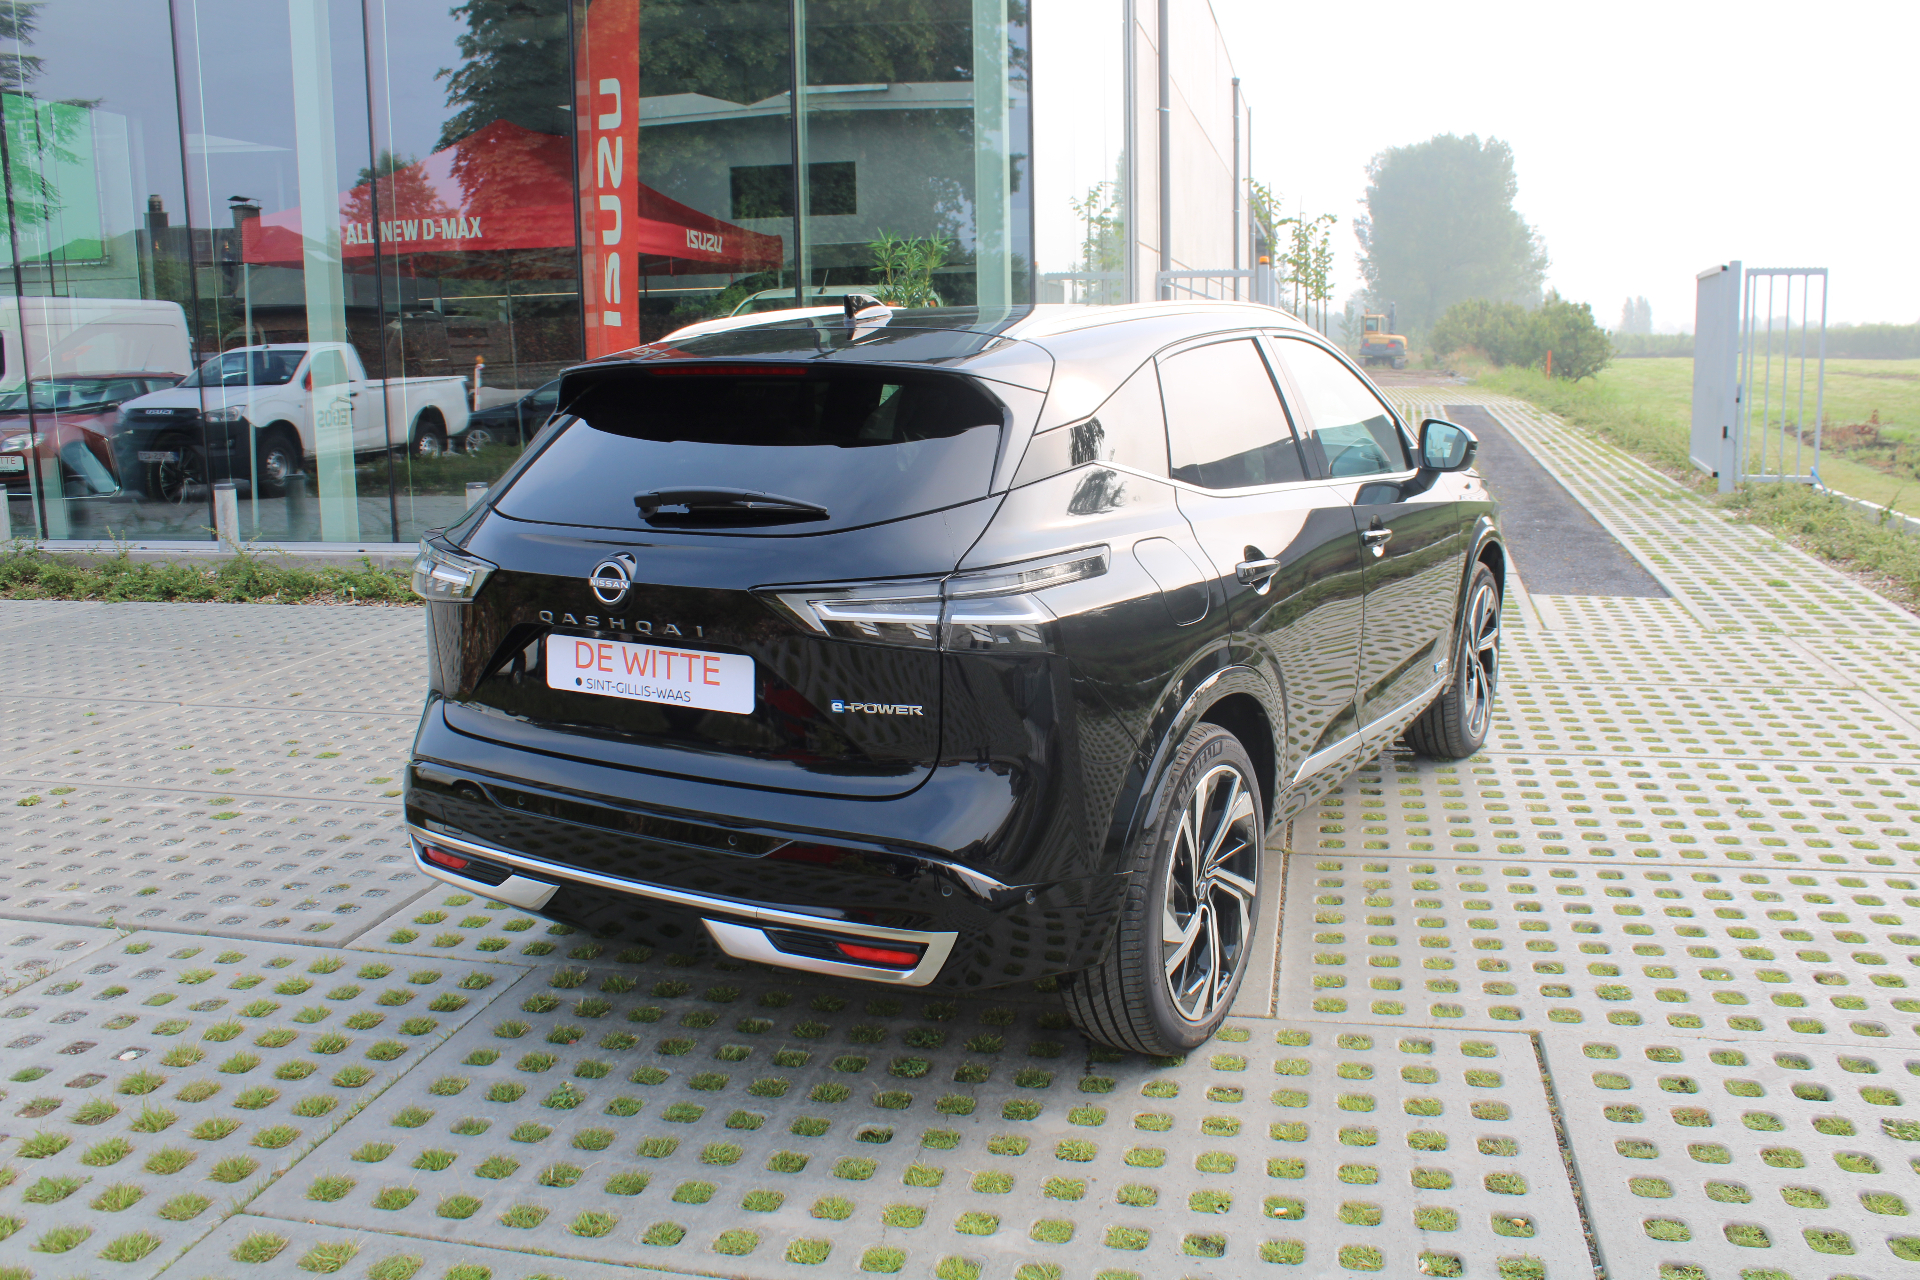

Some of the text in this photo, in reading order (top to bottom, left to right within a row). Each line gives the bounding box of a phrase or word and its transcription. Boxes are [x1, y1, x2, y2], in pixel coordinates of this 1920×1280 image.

[598, 78, 622, 327] ISUZU
[346, 217, 483, 245] ALL NEW D-MAX
[686, 228, 724, 253] ISUZU
[589, 578, 630, 590] NISSAN
[540, 611, 703, 637] QASHQAI
[574, 640, 721, 687] DE WITTE
[586, 678, 691, 703] SINT-GILLIS-WAAS
